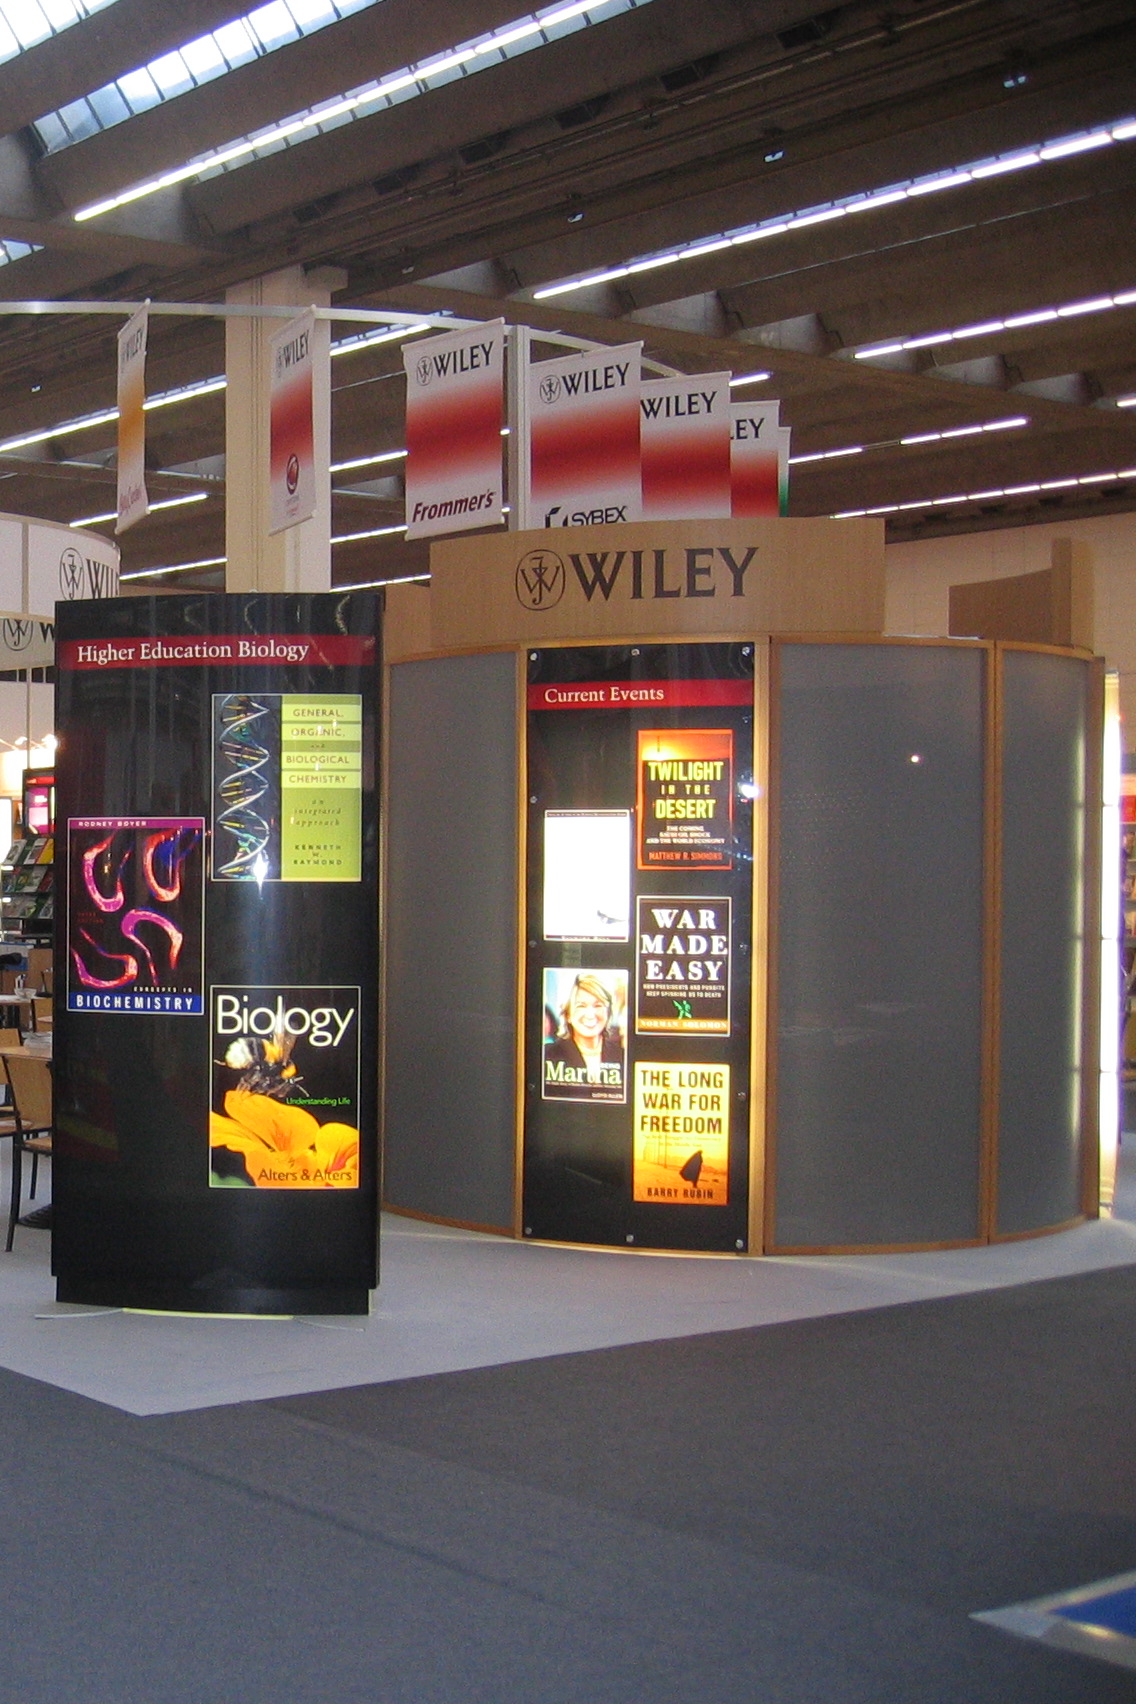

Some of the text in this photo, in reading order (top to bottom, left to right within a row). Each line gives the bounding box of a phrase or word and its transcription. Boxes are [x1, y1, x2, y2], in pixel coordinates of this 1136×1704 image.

[283, 329, 310, 369] WILEY
[432, 341, 494, 377] WILEY
[561, 362, 630, 396] WILEY
[640, 391, 717, 420] WILEY
[413, 489, 495, 523] Frommer's
[571, 505, 627, 526] SYBEX
[568, 546, 759, 602] WILEY
[77, 640, 310, 666] Higher Education Biology
[544, 686, 665, 703] Current Events
[286, 755, 350, 764] BIOLOGICAL
[289, 775, 347, 783] CHEMISTRY
[647, 761, 724, 781] TWILIGHT
[661, 784, 711, 795] IN THE
[655, 799, 717, 819] DESERT
[651, 908, 717, 930] WAR
[640, 934, 728, 955] MADE
[645, 959, 723, 980] EASY
[76, 994, 193, 1010] BIOCHEMISTRY
[216, 994, 355, 1047] Biology
[545, 1060, 622, 1085] Martha
[641, 1070, 724, 1088] THE LONG
[286, 1097, 351, 1107] Understanding Life
[642, 1093, 721, 1111] WAR FOR
[640, 1115, 723, 1134] FREEDOM
[257, 1168, 353, 1182] Alters & Alters
[647, 1187, 714, 1199] BARRY RUBIN
